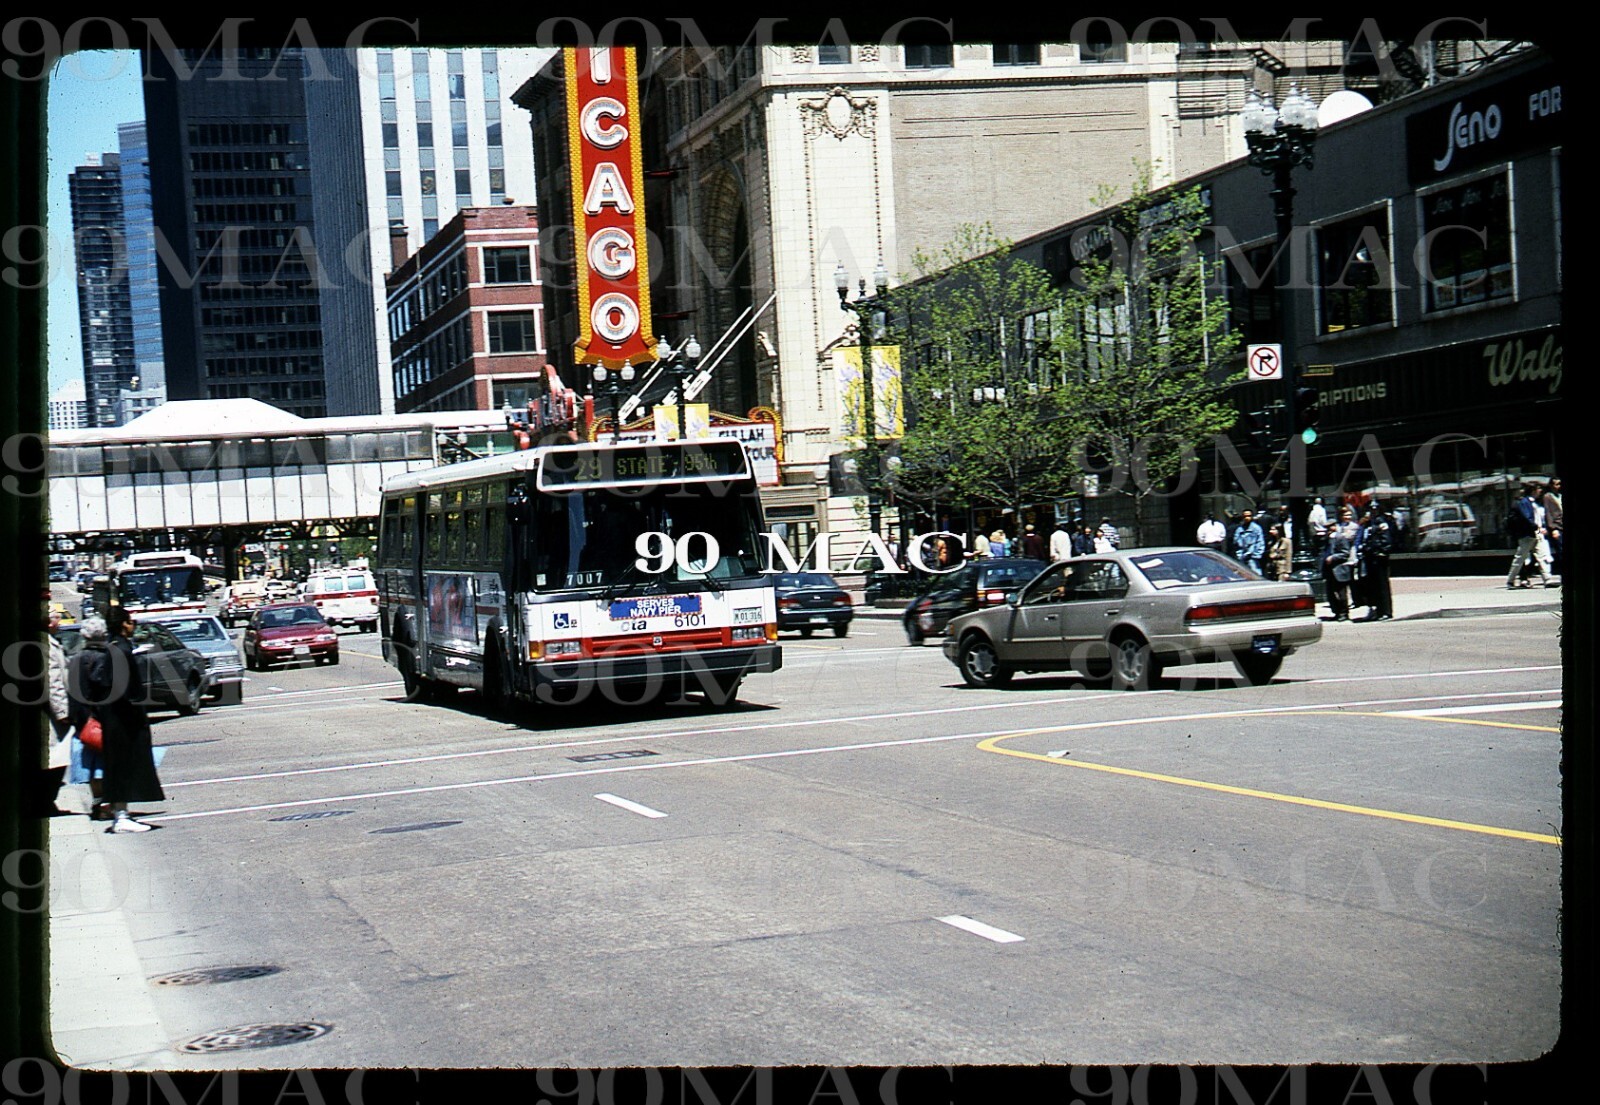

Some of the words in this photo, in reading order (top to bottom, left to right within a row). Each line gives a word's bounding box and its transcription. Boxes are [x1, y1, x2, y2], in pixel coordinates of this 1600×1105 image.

[1529, 86, 1561, 120] FOR
[1312, 381, 1388, 409] RIPTIONS
[573, 458, 603, 481] 29
[616, 455, 668, 476] STATE
[684, 452, 718, 472] 95th
[566, 572, 604, 587] 7007
[630, 606, 660, 618] NAVY
[660, 604, 682, 616] PIER
[636, 598, 675, 610] SERVES
[673, 614, 706, 628] 6101
